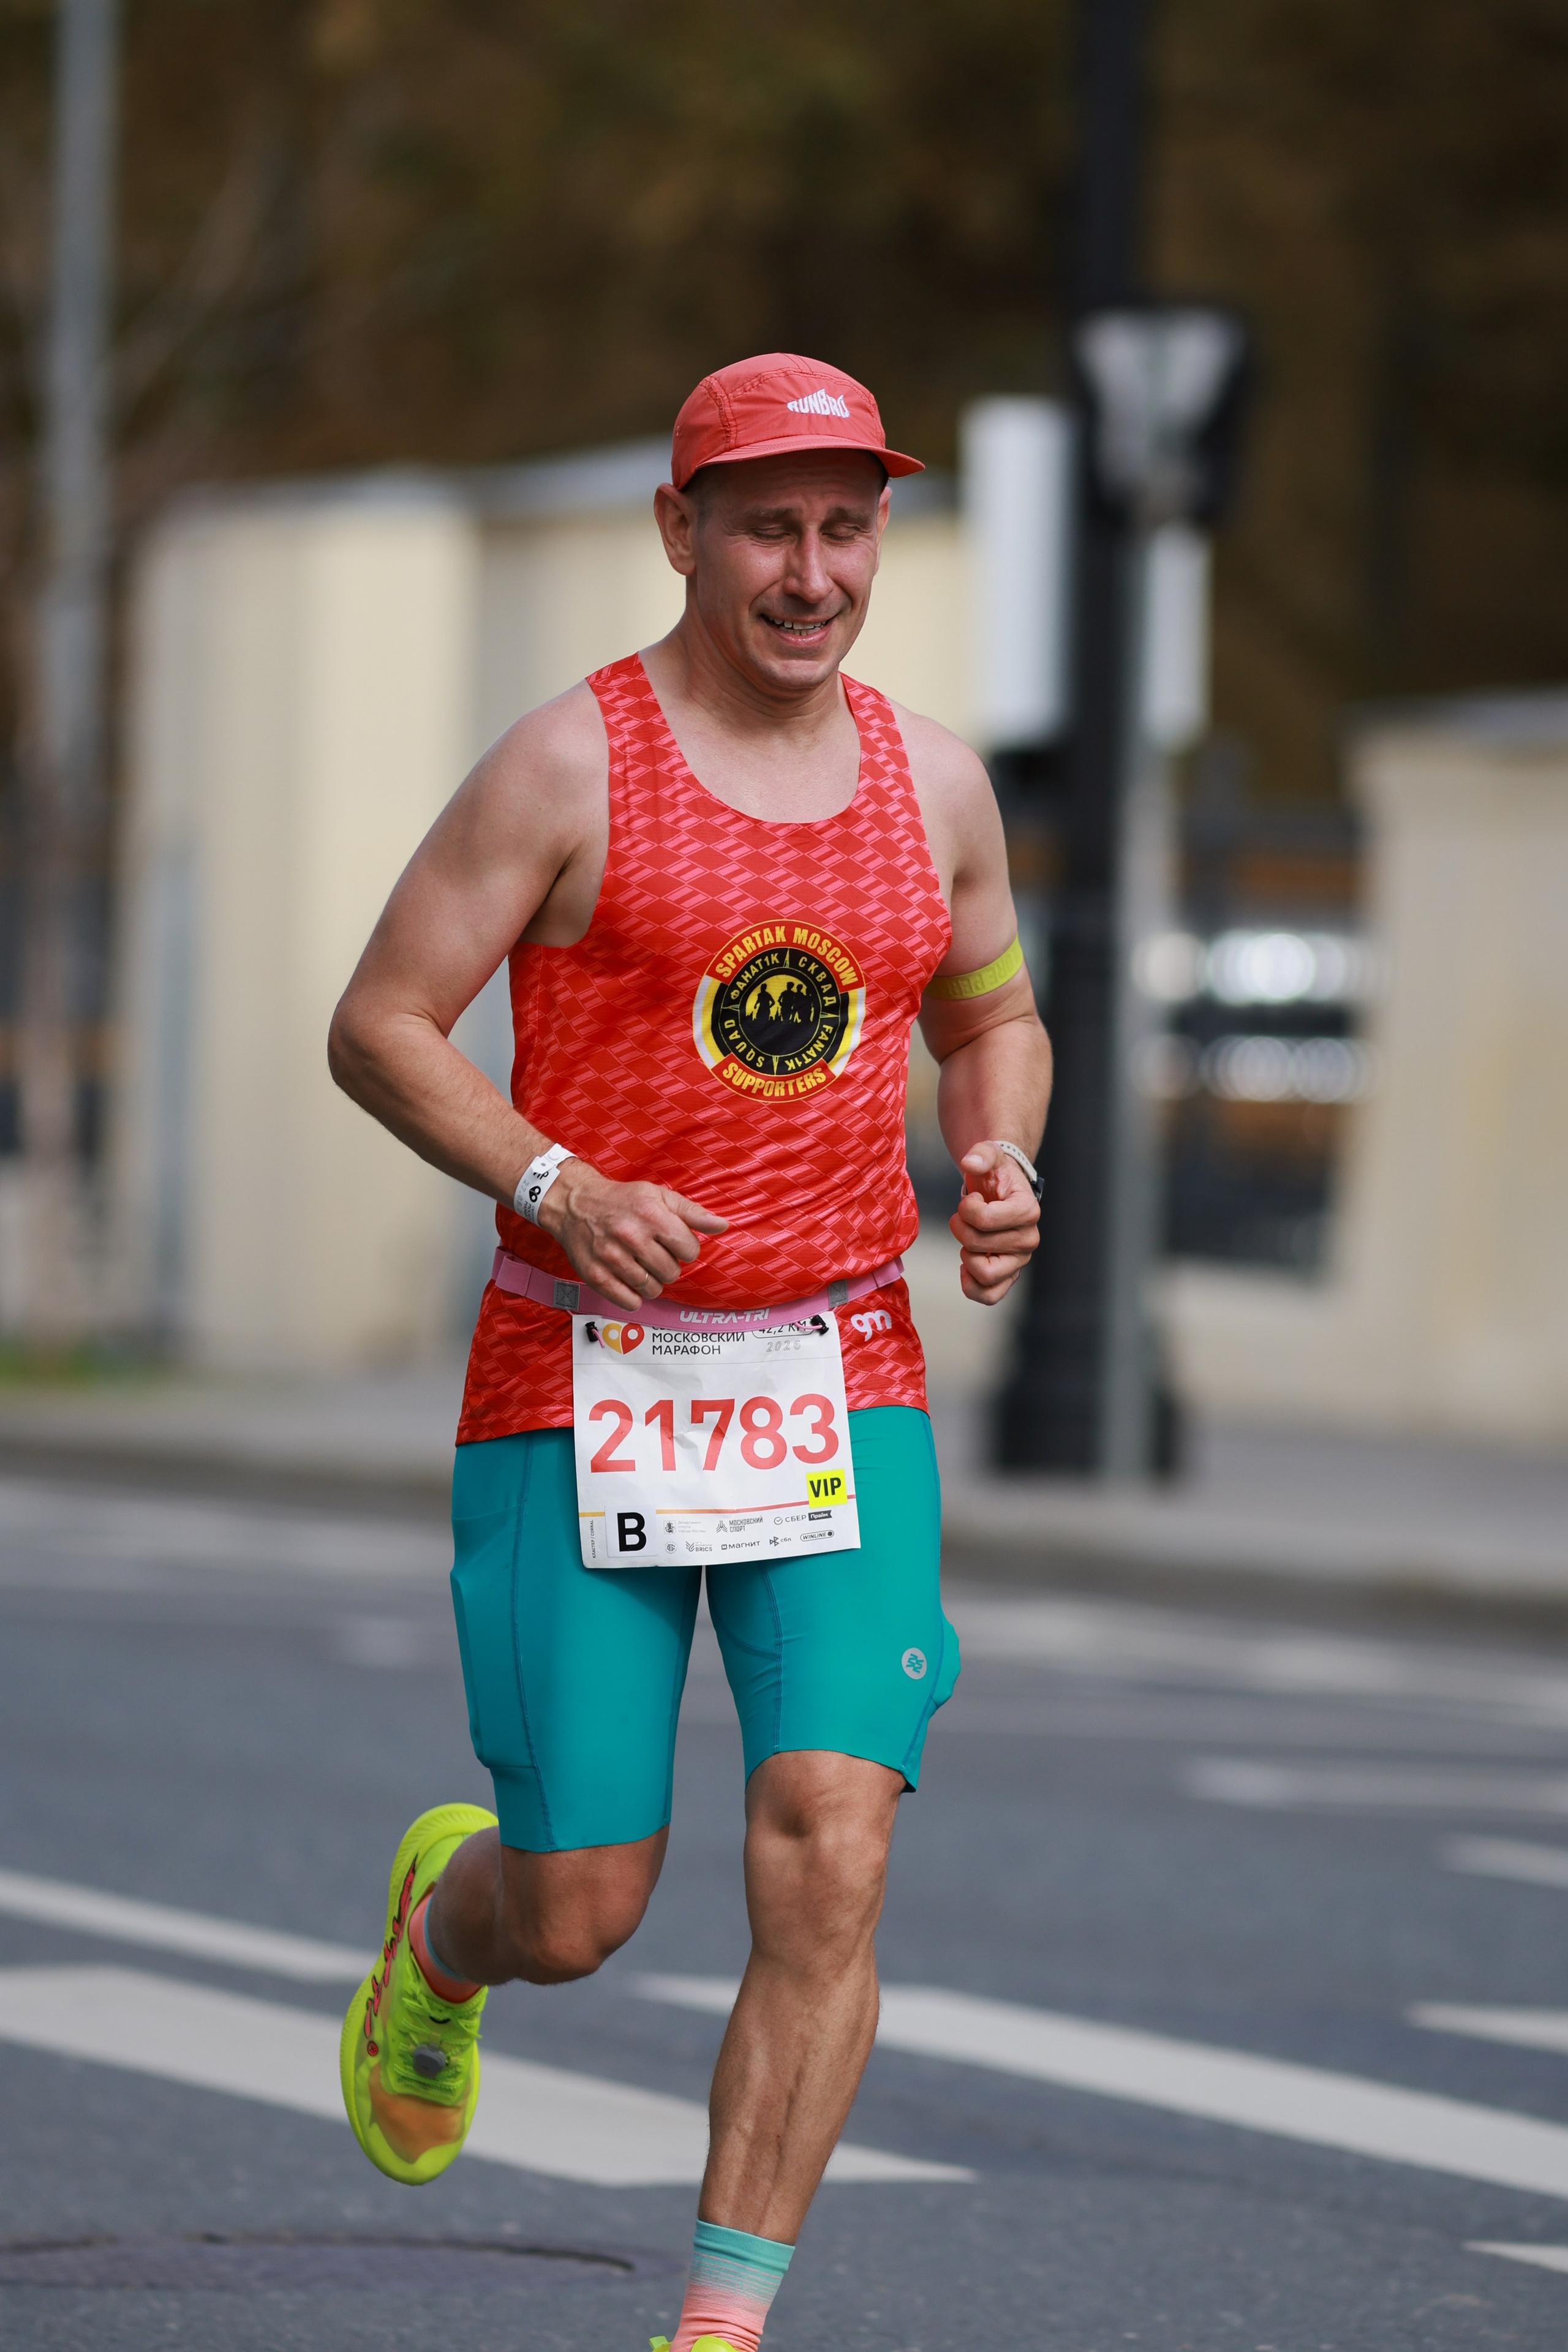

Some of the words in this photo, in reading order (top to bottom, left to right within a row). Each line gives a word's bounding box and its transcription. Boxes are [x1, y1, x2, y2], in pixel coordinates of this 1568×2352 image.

[786, 388, 850, 418] RUNBRO
[715, 925, 786, 978] SPARTAK
[793, 927, 859, 986] MOSCOW
[799, 956, 837, 1007] СКВАД
[725, 1019, 765, 1068] SQUAD
[722, 1062, 827, 1097] SUPPORTERS
[679, 1308, 770, 1324] ULTRA-TRI
[652, 1332, 745, 1343] МОСКОВСКИЙ
[652, 1345, 720, 1355] МАРАФОН
[766, 1340, 801, 1352] 2026
[588, 1393, 839, 1473] 21783
[809, 1477, 842, 1498] VIP
[729, 1516, 763, 1526] МОСКОВСКИЙ
[785, 1514, 807, 1523] СБЕР
[617, 1512, 647, 1552] B
